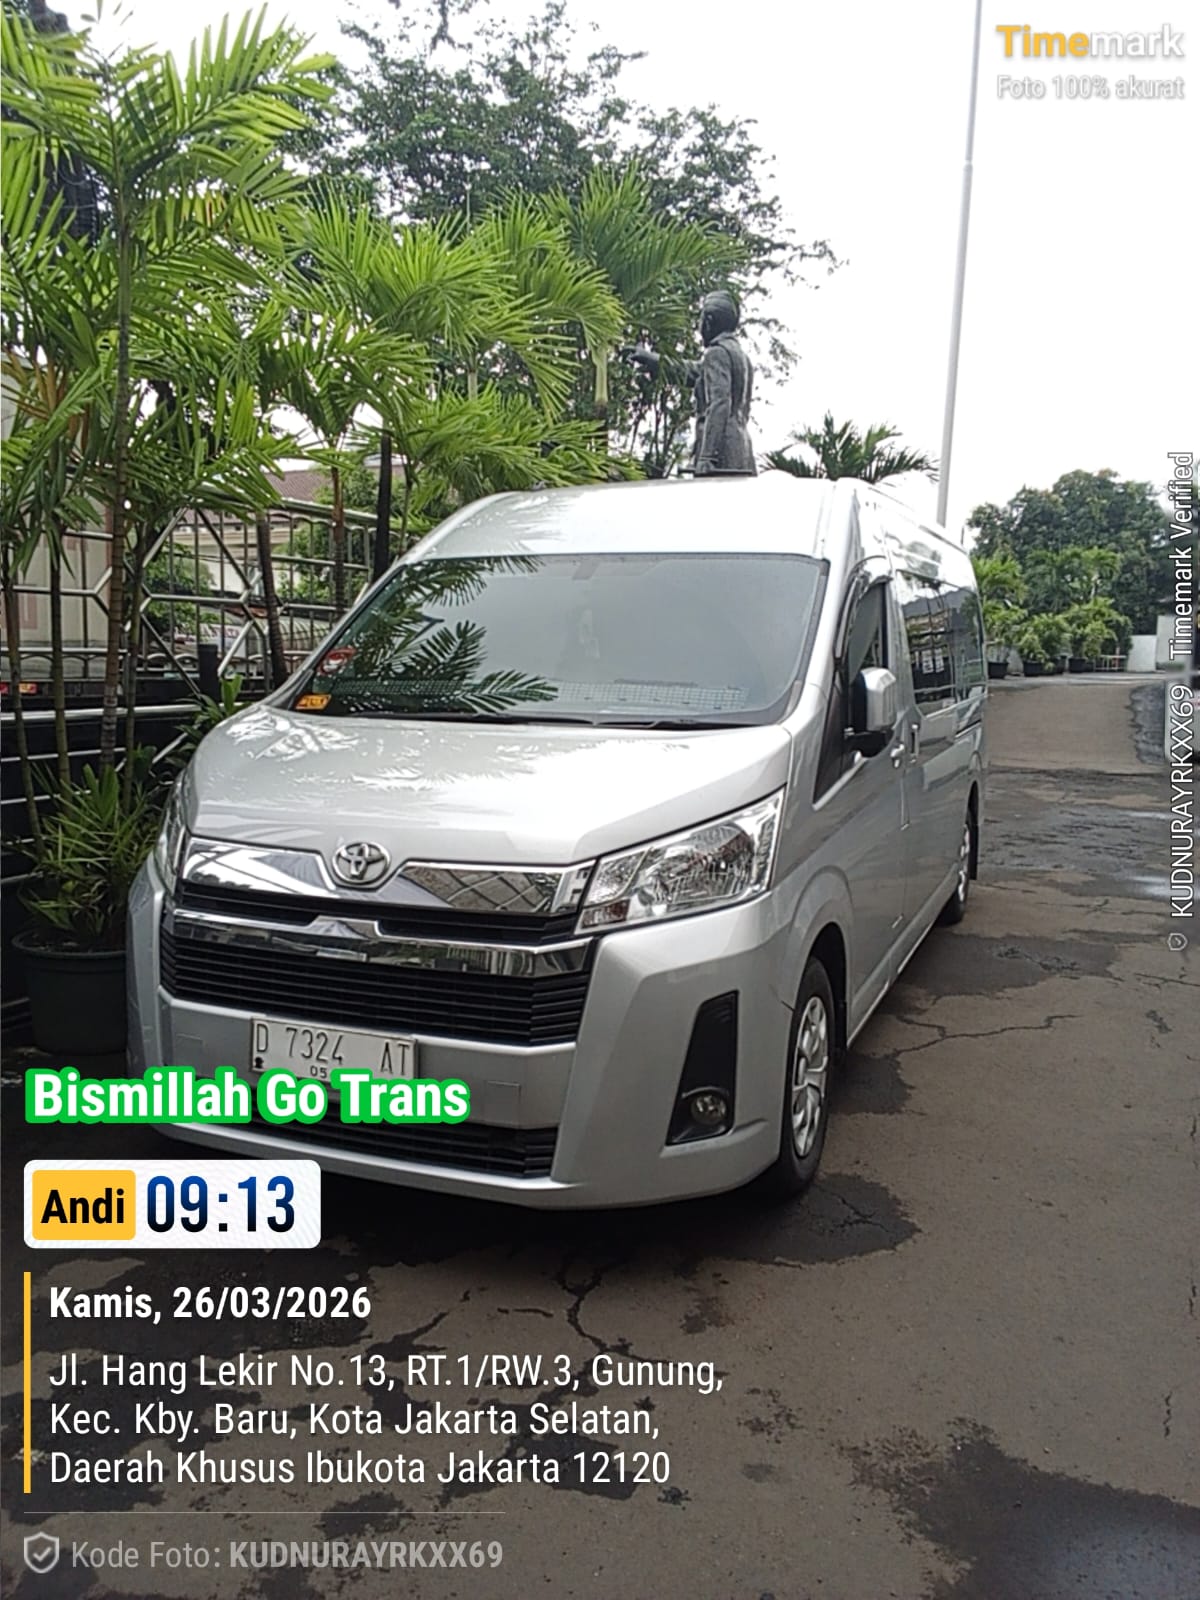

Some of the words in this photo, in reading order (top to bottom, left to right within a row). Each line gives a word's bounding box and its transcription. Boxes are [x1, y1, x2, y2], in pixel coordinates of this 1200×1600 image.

[256, 1023, 269, 1053] D
[285, 1027, 344, 1066] 7324
[380, 1041, 410, 1076] AT
